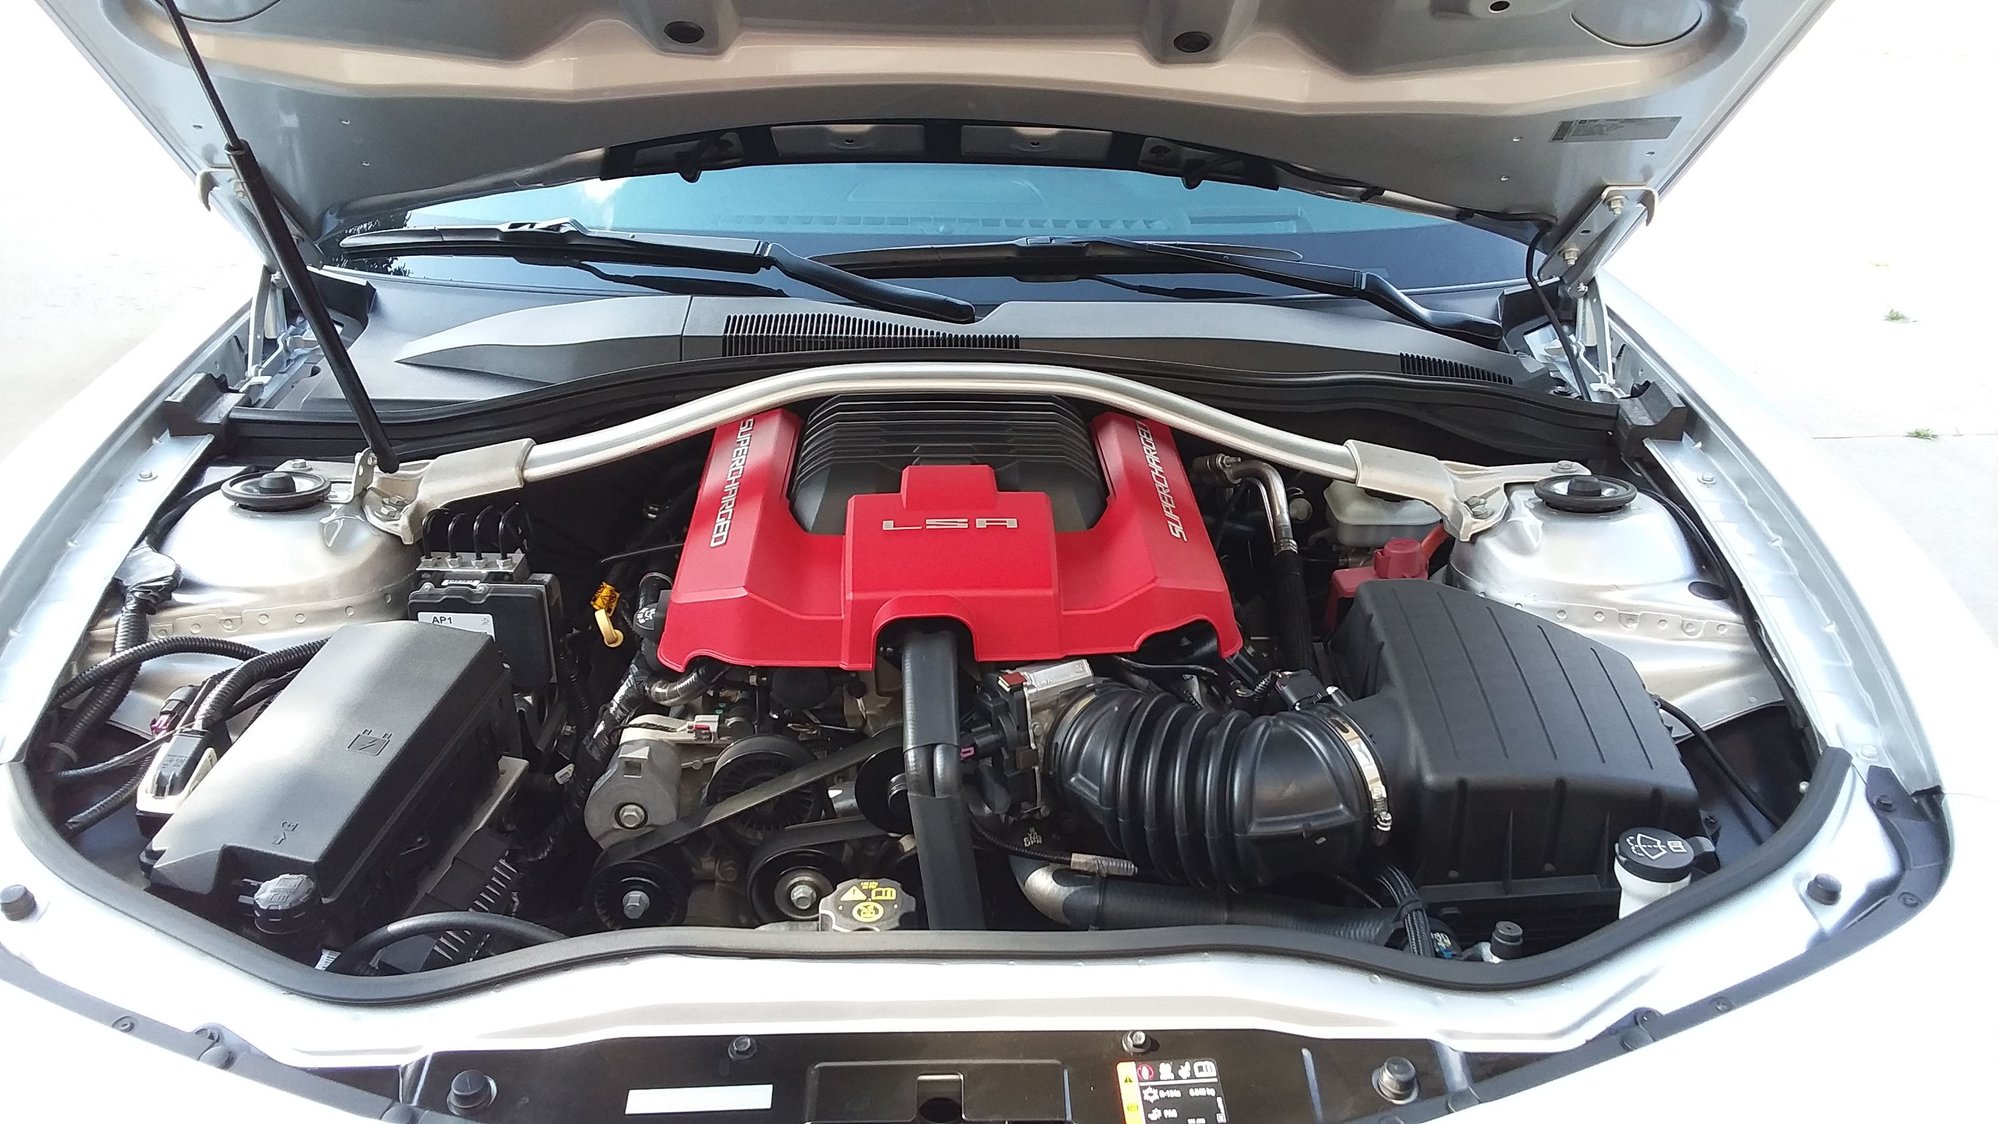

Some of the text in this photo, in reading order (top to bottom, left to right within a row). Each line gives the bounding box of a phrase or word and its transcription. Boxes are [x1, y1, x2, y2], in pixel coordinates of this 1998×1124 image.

[710, 418, 754, 547] SUPERCHARGED
[1136, 421, 1187, 541] SUPERCHARGED
[882, 518, 1018, 531] LSA
[432, 616, 452, 625] AP1
